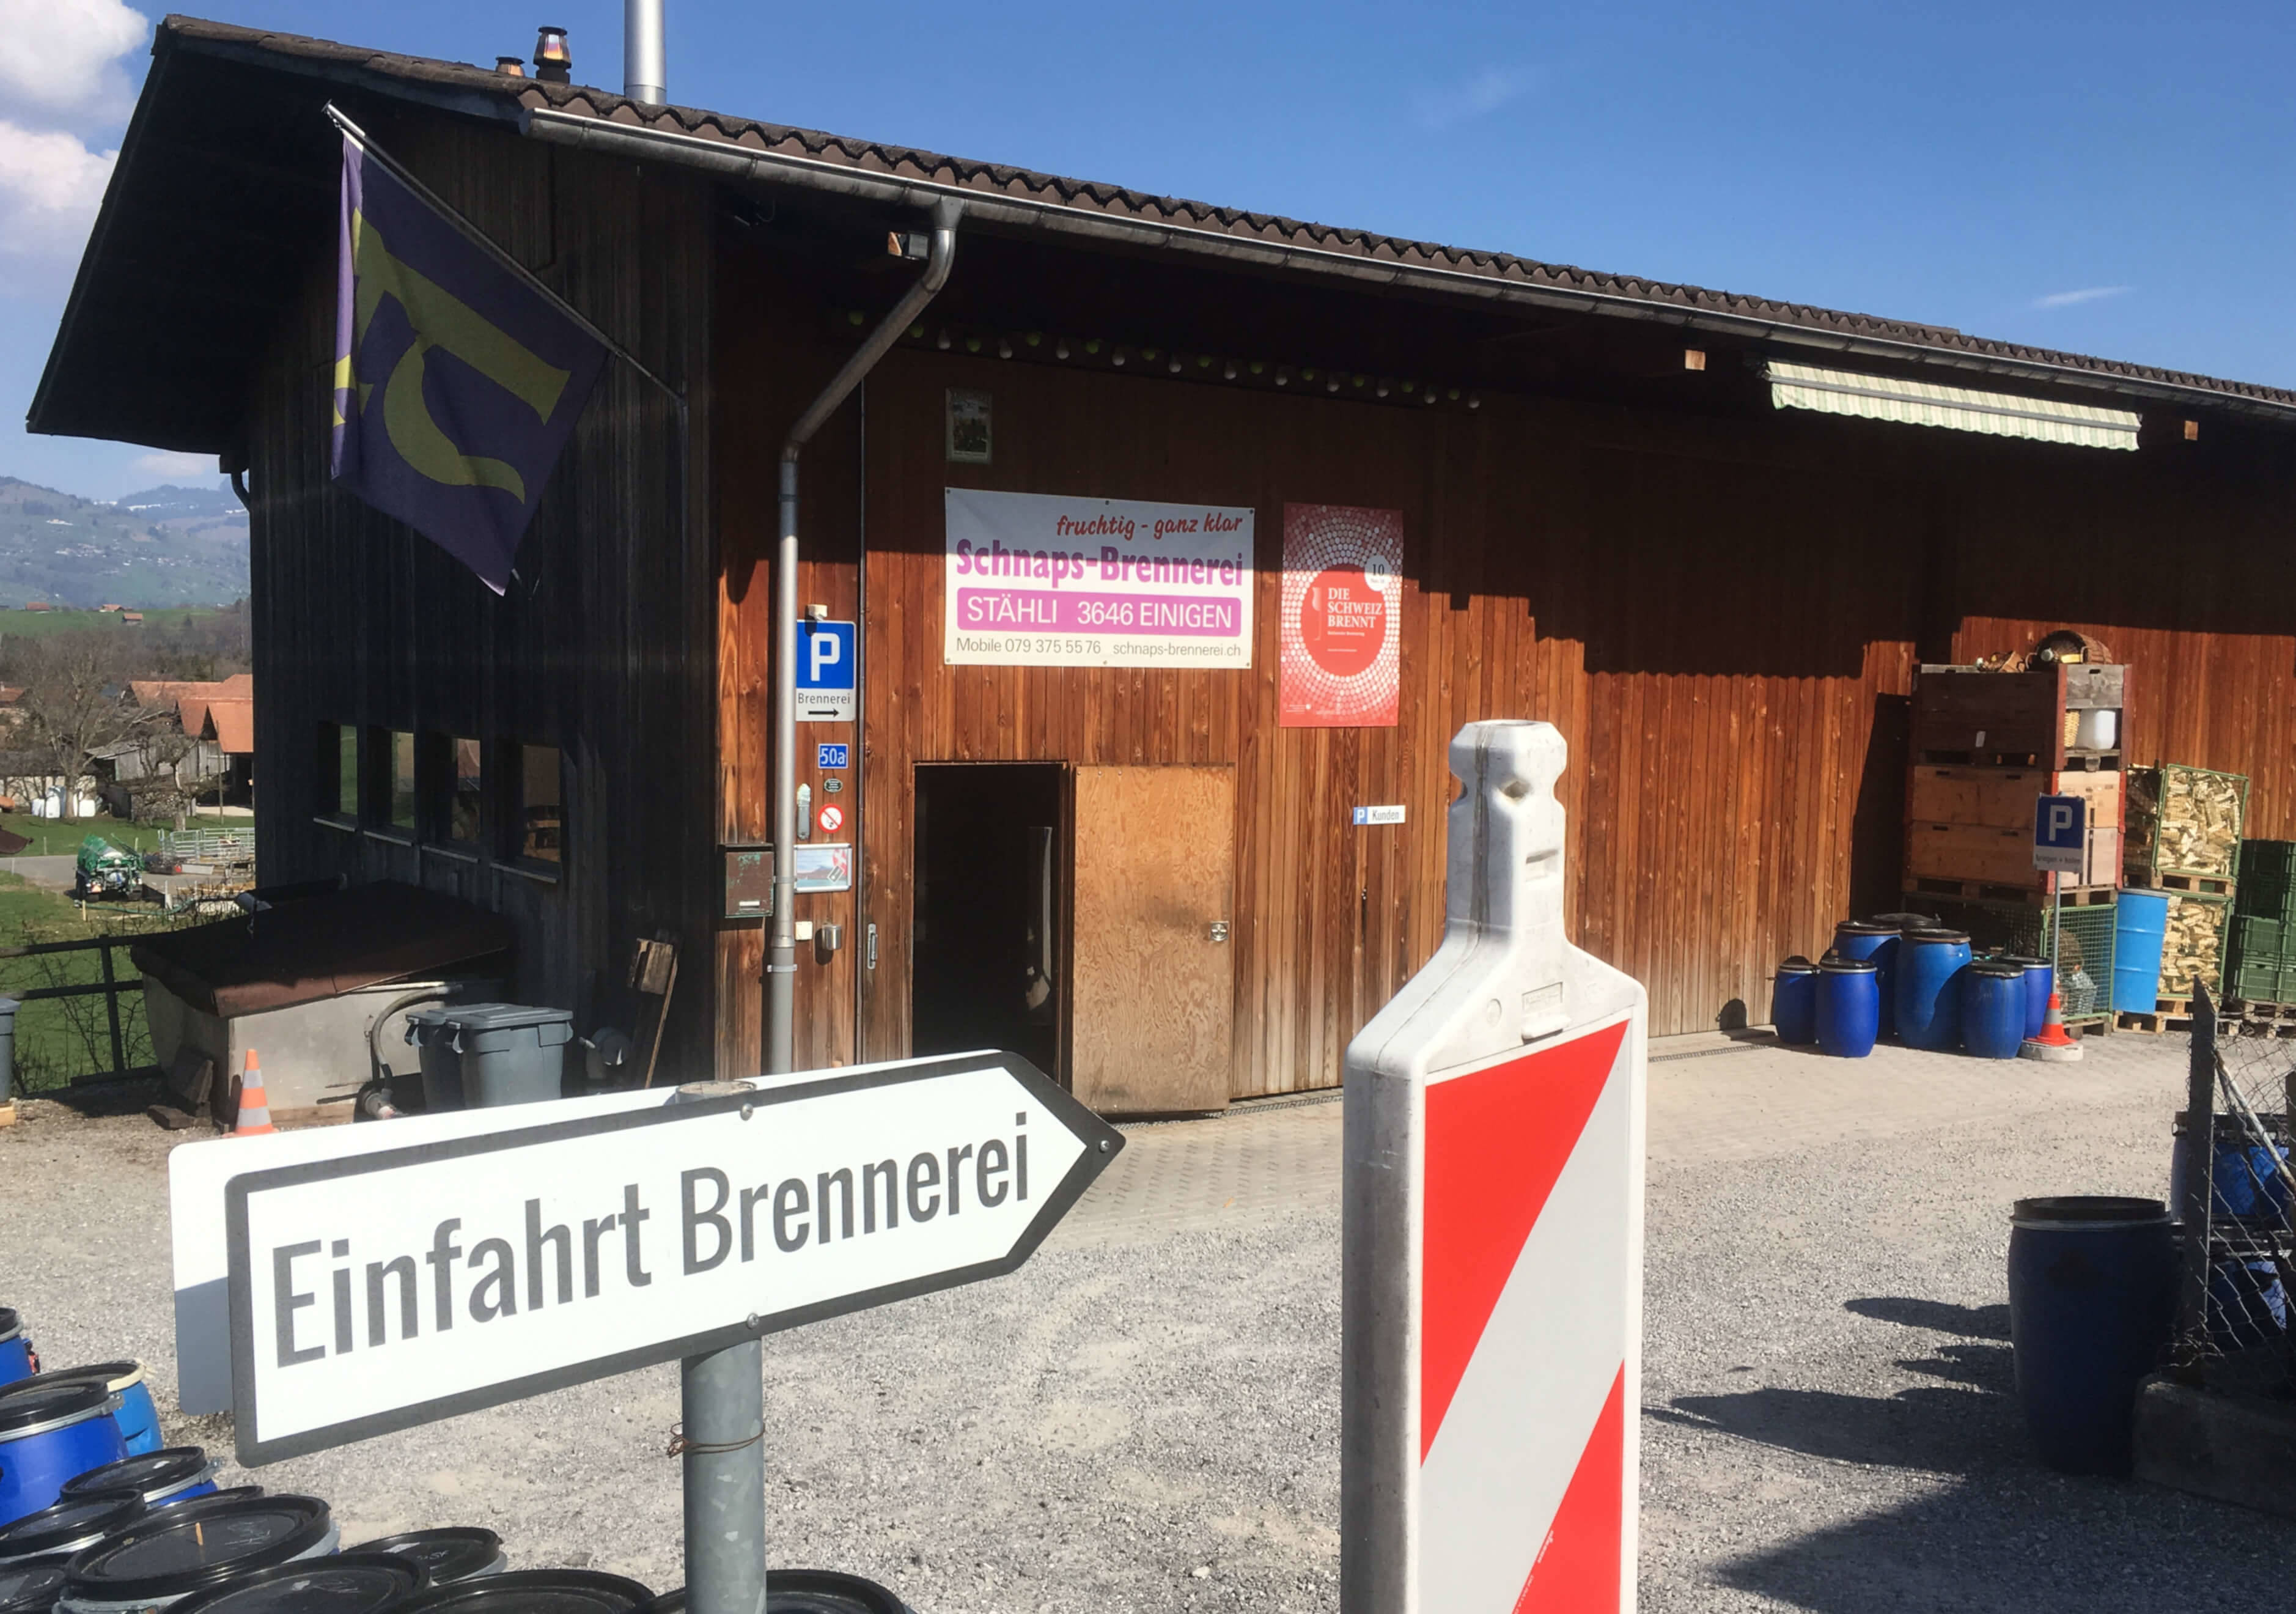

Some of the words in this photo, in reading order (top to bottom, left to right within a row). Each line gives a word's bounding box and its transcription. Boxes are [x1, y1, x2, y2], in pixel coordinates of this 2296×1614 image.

[1056, 515, 1136, 540] fruchtig
[1154, 518, 1198, 539] ganz
[1204, 513, 1243, 532] klar
[956, 539, 1243, 589] Schnaps-Brennerei
[1328, 588, 1350, 600] DIE
[967, 593, 1058, 624] STÄHLI
[1077, 601, 1134, 626] 3646
[1140, 603, 1232, 628] EINIGEN
[1327, 602, 1383, 615] SCHWEIZ
[1328, 614, 1375, 628] BRENNT
[811, 632, 841, 682] P
[956, 637, 1002, 653] Mobile
[1005, 638, 1031, 653] 079
[1036, 639, 1062, 654] 375
[1113, 642, 1242, 657] schnaps-brennerei.ch
[798, 692, 852, 705] Brennerei
[821, 748, 846, 765] 50a
[1357, 809, 1365, 823] P
[1372, 809, 1399, 821] Kunden
[2048, 805, 2073, 841] P
[273, 1184, 651, 1368] Einfahrt
[681, 1111, 1029, 1277] Brennerei
